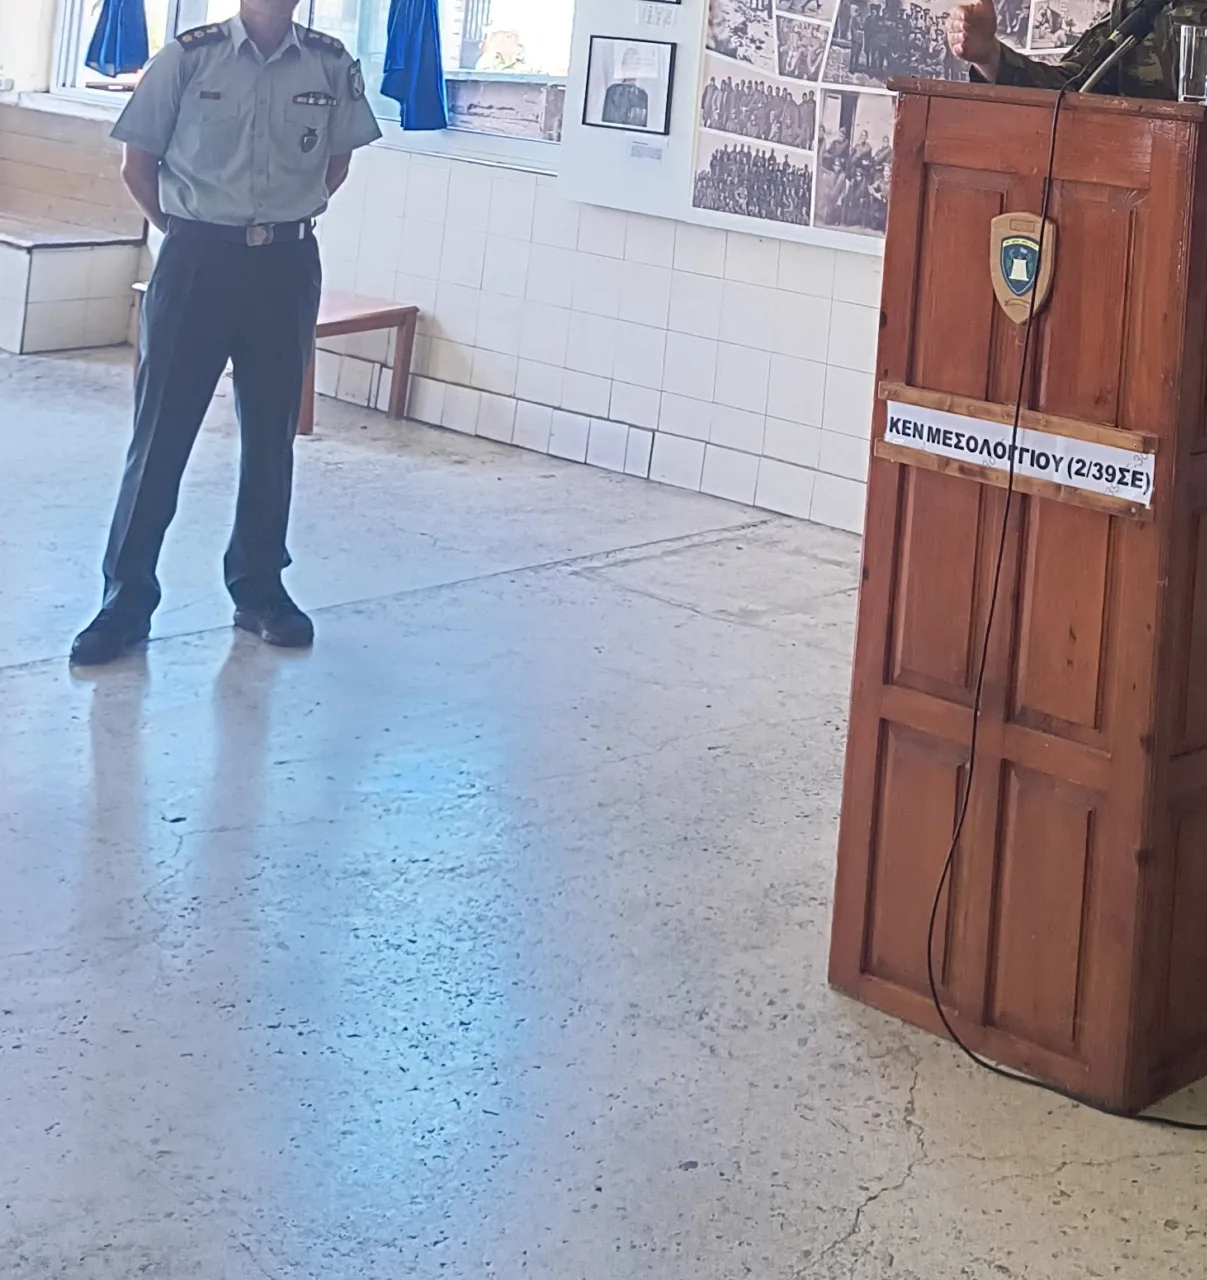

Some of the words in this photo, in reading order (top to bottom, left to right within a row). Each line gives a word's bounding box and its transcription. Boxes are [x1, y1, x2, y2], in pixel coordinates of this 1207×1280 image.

[889, 416, 924, 440] ΚΕΝ
[926, 426, 1064, 473] ΜΕΣΟΛΟΓΓΙΟΥ
[1067, 456, 1151, 496] (2/39ΣΕ)
